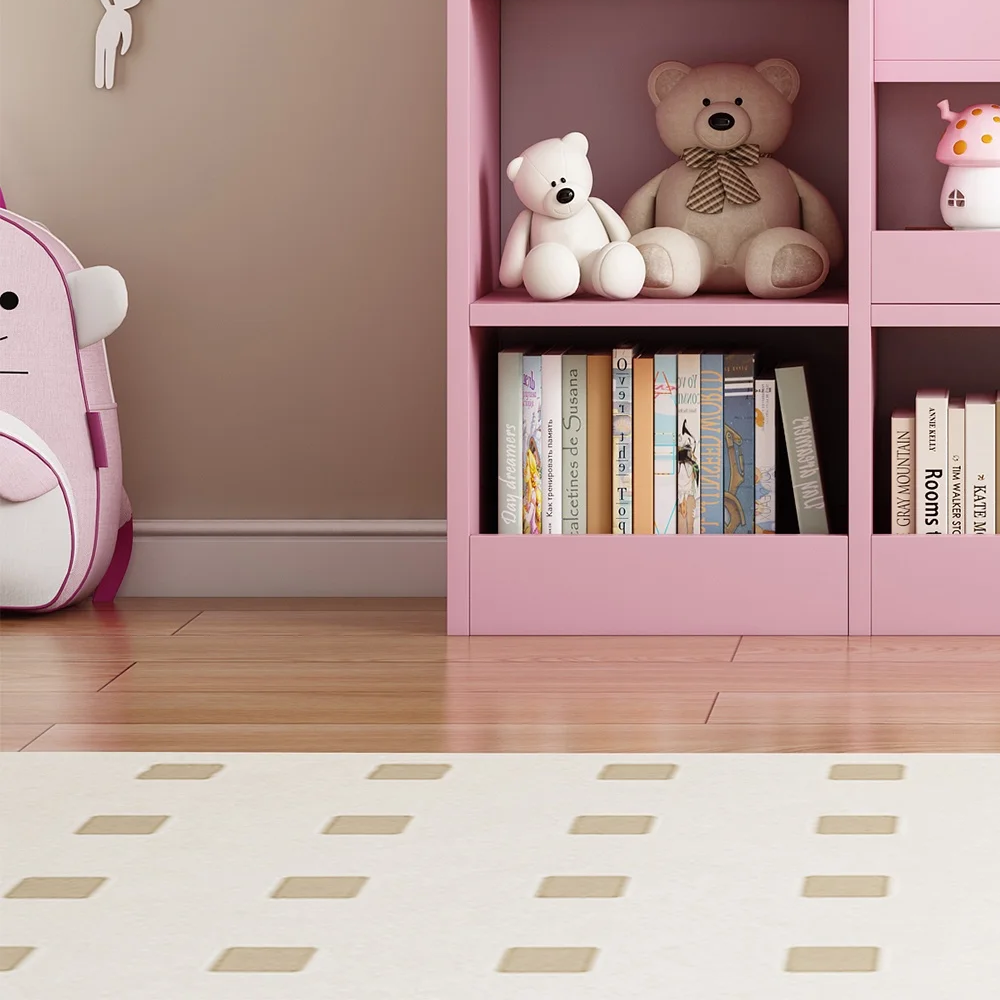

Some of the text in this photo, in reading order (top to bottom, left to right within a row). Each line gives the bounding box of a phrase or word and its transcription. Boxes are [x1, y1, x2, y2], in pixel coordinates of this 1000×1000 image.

[563, 369, 581, 432] Susana
[562, 437, 579, 456] de
[499, 424, 523, 525] Day dreamers
[547, 453, 555, 500] тренировать
[897, 431, 910, 527] GRAY MOUNTAIN
[925, 469, 943, 526] Rooms
[952, 466, 961, 480] TIM
[952, 483, 961, 518] WALKER
[974, 485, 986, 534] KATE M
